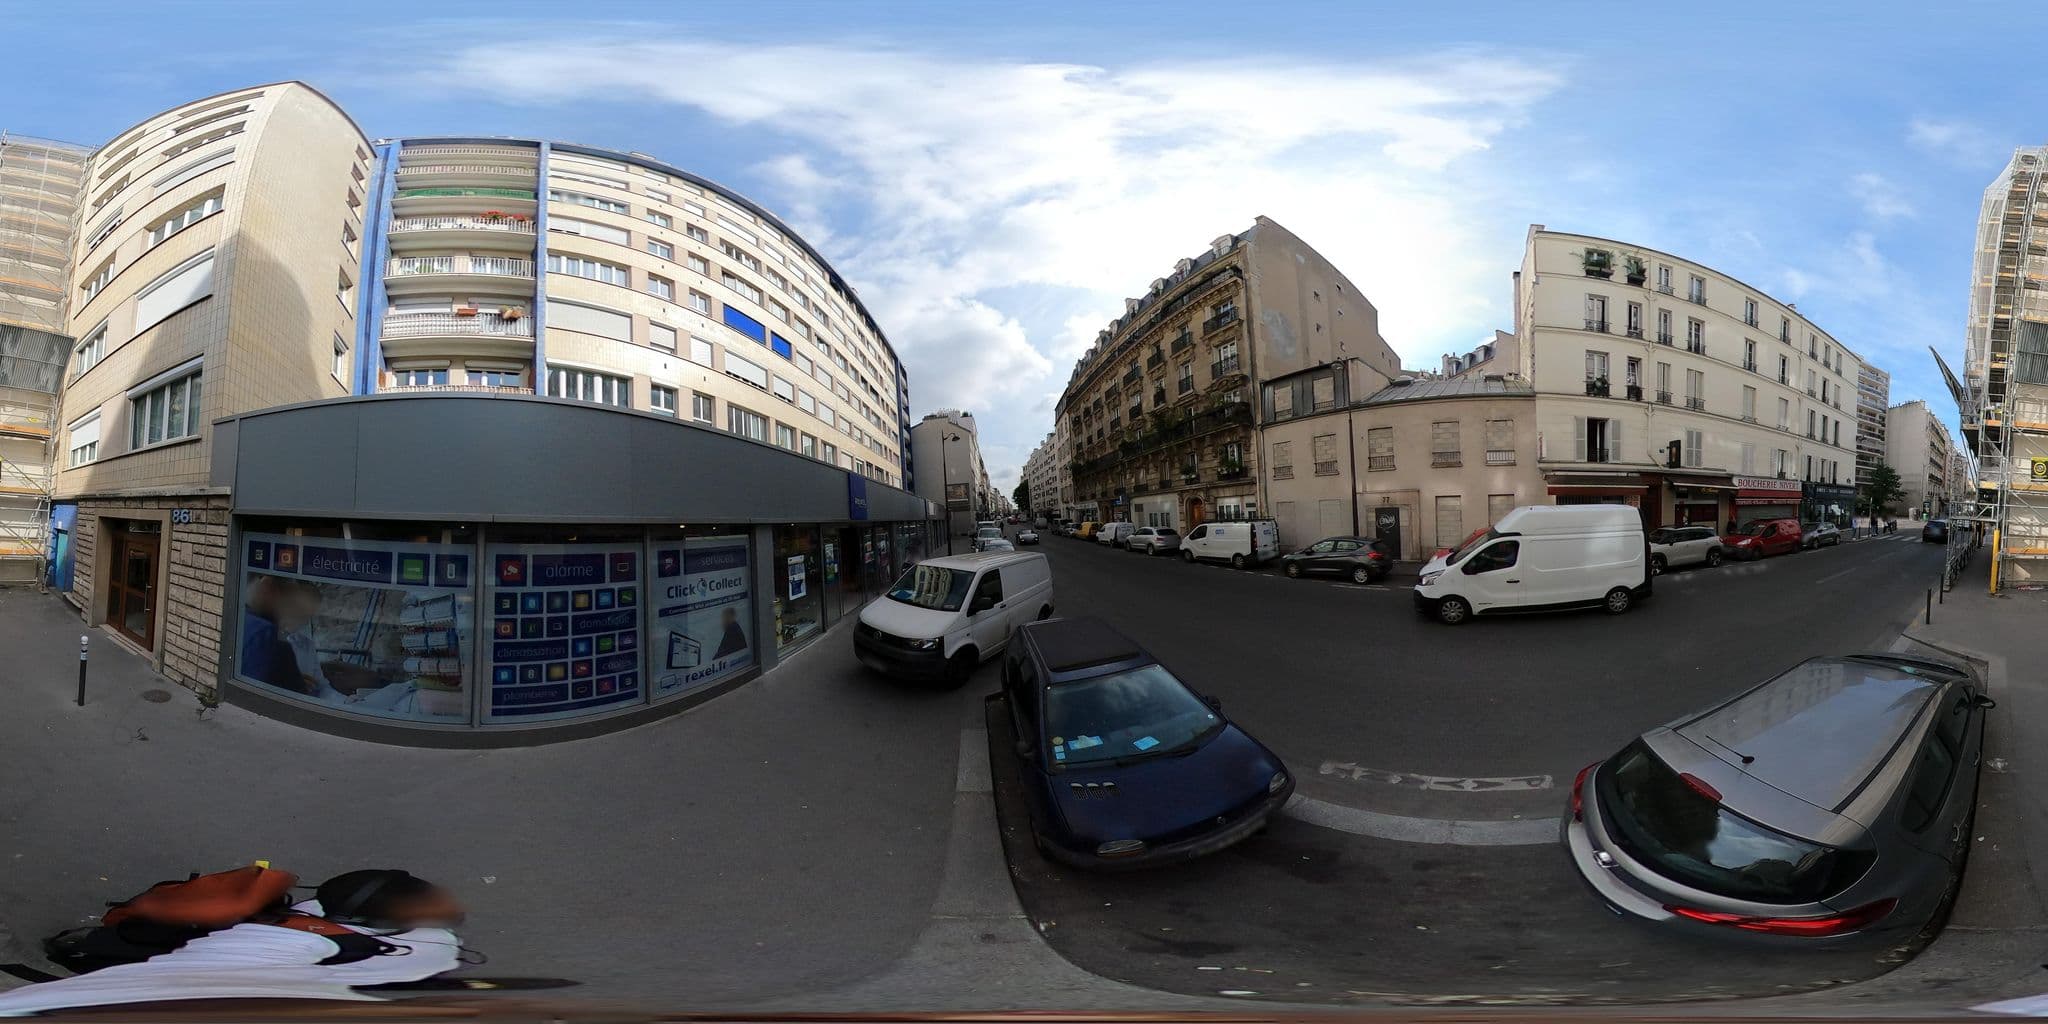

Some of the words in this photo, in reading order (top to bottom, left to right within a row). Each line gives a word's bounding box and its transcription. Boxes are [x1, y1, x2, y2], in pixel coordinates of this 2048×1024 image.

[1738, 479, 1777, 489] BOUCHERIE
[172, 508, 190, 524] 86
[312, 554, 380, 575] électricité
[545, 563, 593, 578] alarme
[667, 583, 696, 599] Click
[709, 577, 743, 592] Collect
[685, 661, 726, 683] rexel.fr
